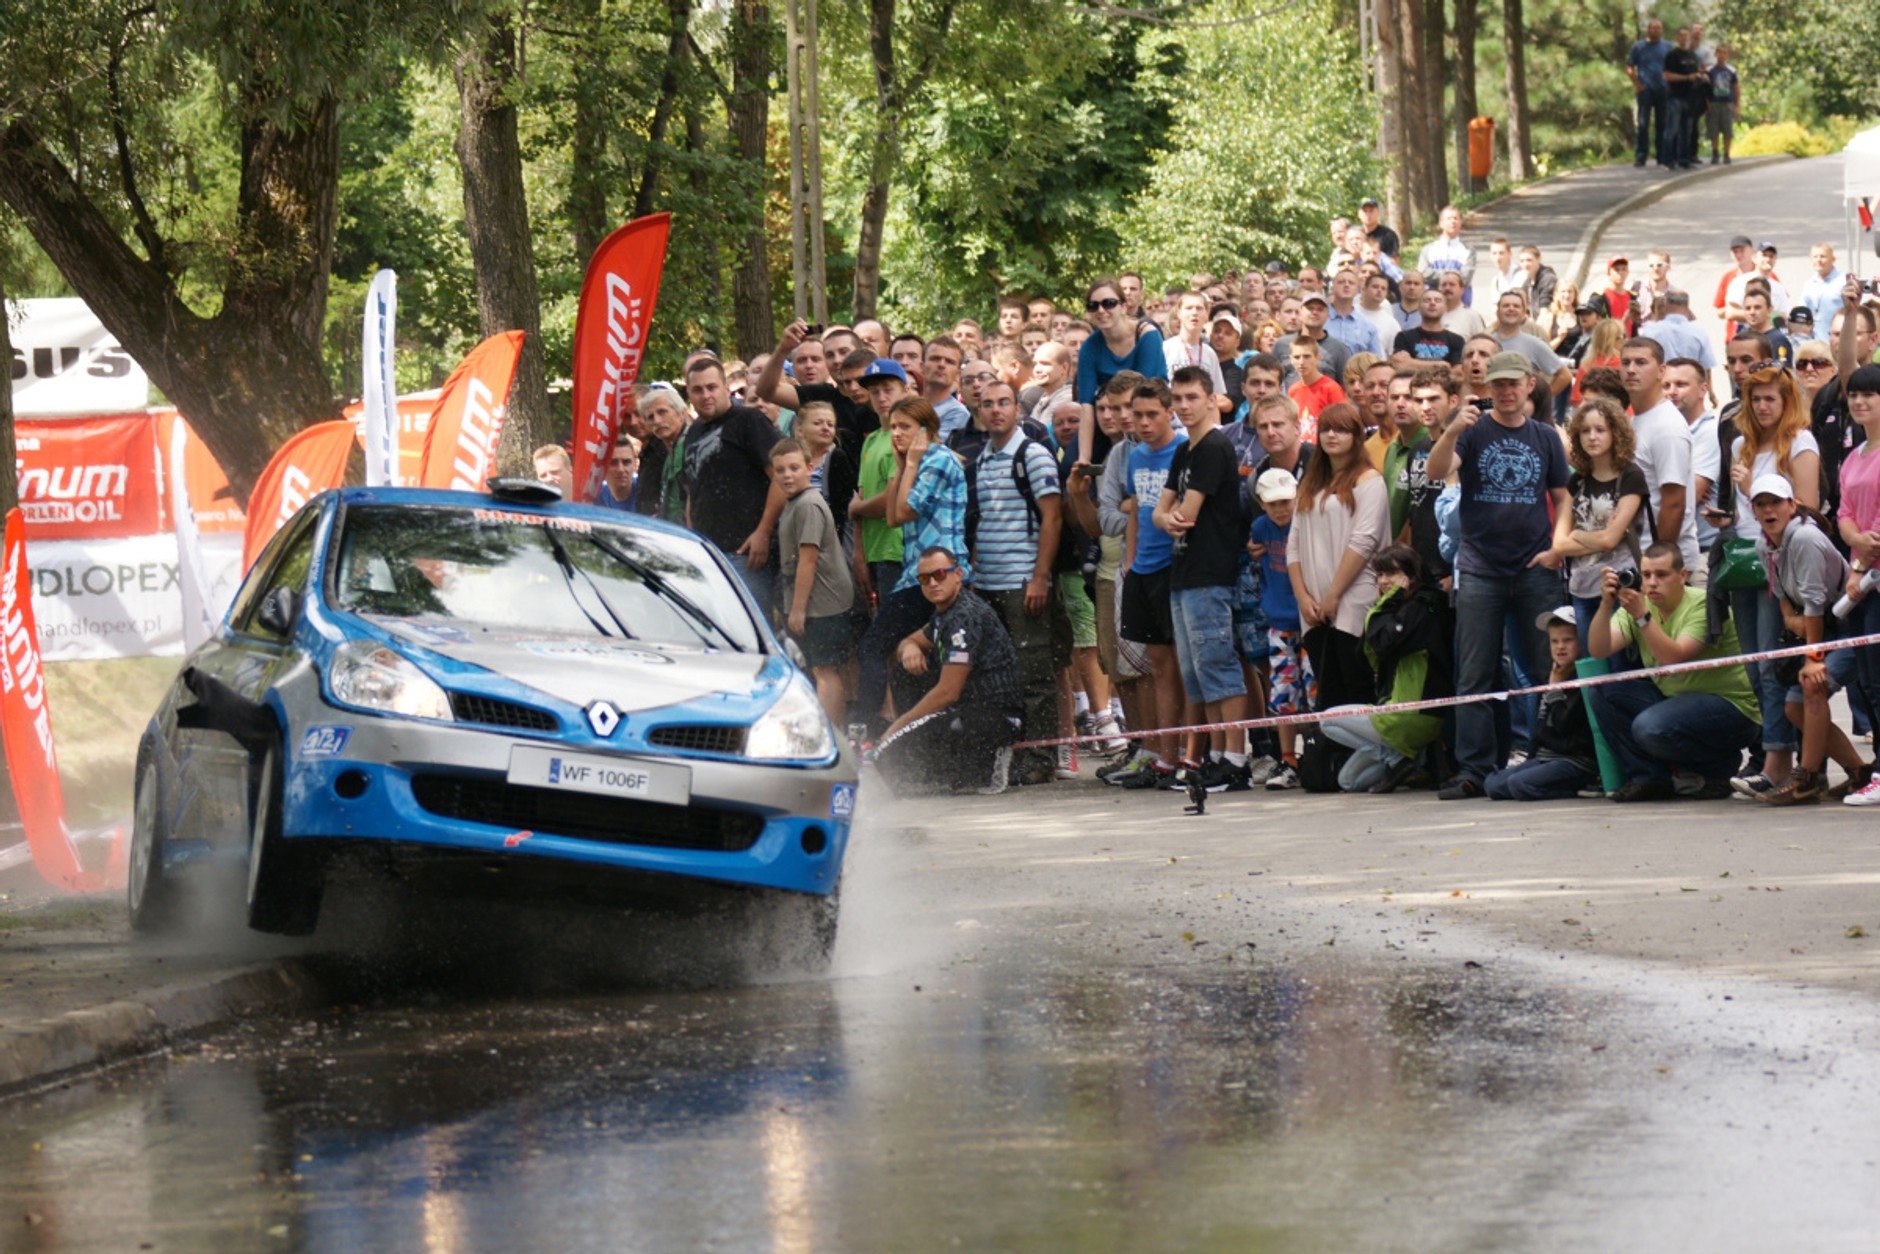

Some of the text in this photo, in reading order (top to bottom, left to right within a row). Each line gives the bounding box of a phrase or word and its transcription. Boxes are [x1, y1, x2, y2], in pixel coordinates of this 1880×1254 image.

[75, 500, 121, 522] OIL
[563, 765, 648, 789] WF 1006F
